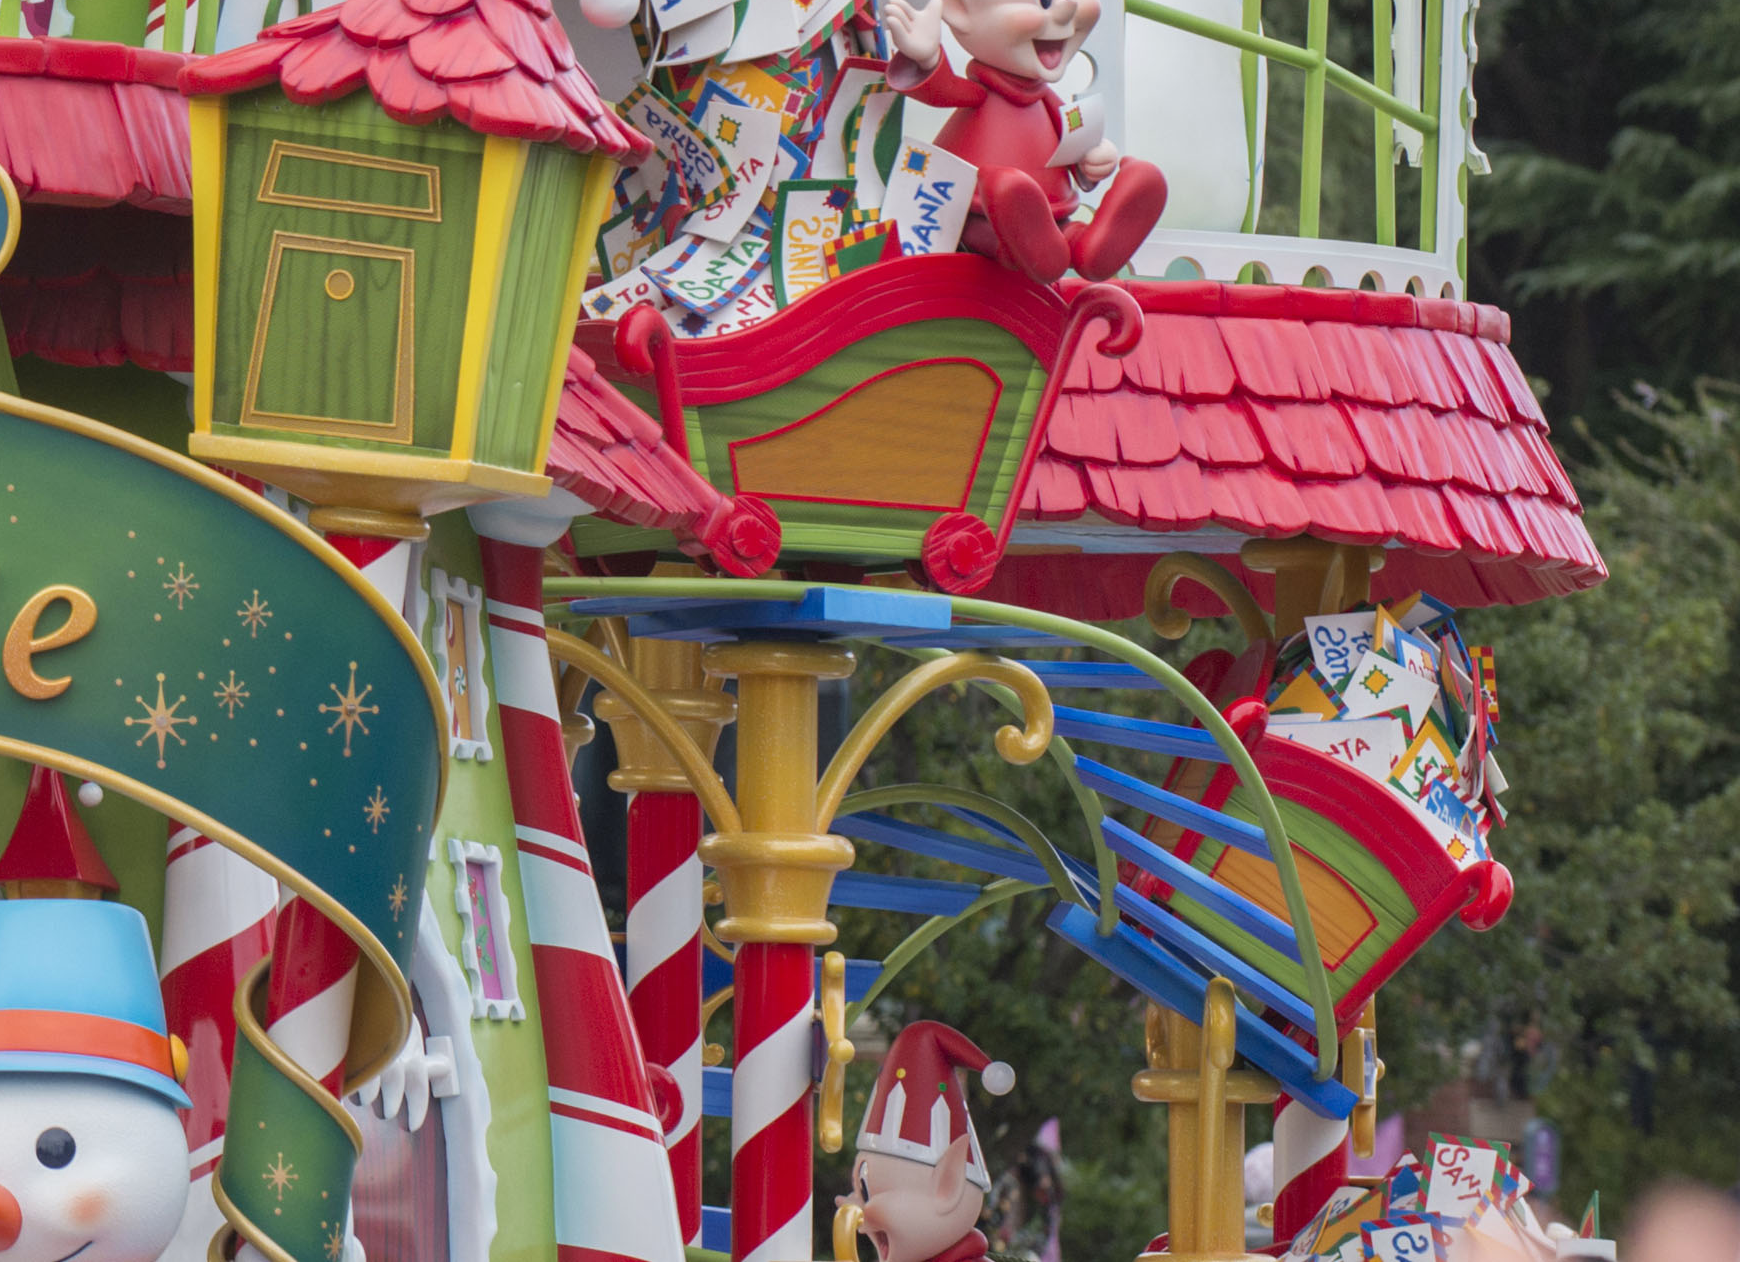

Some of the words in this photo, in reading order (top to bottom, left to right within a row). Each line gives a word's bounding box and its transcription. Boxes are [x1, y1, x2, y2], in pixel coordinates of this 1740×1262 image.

[616, 283, 649, 304] TO
[677, 241, 764, 300] SANTA
[1437, 1145, 1481, 1200] SANT
